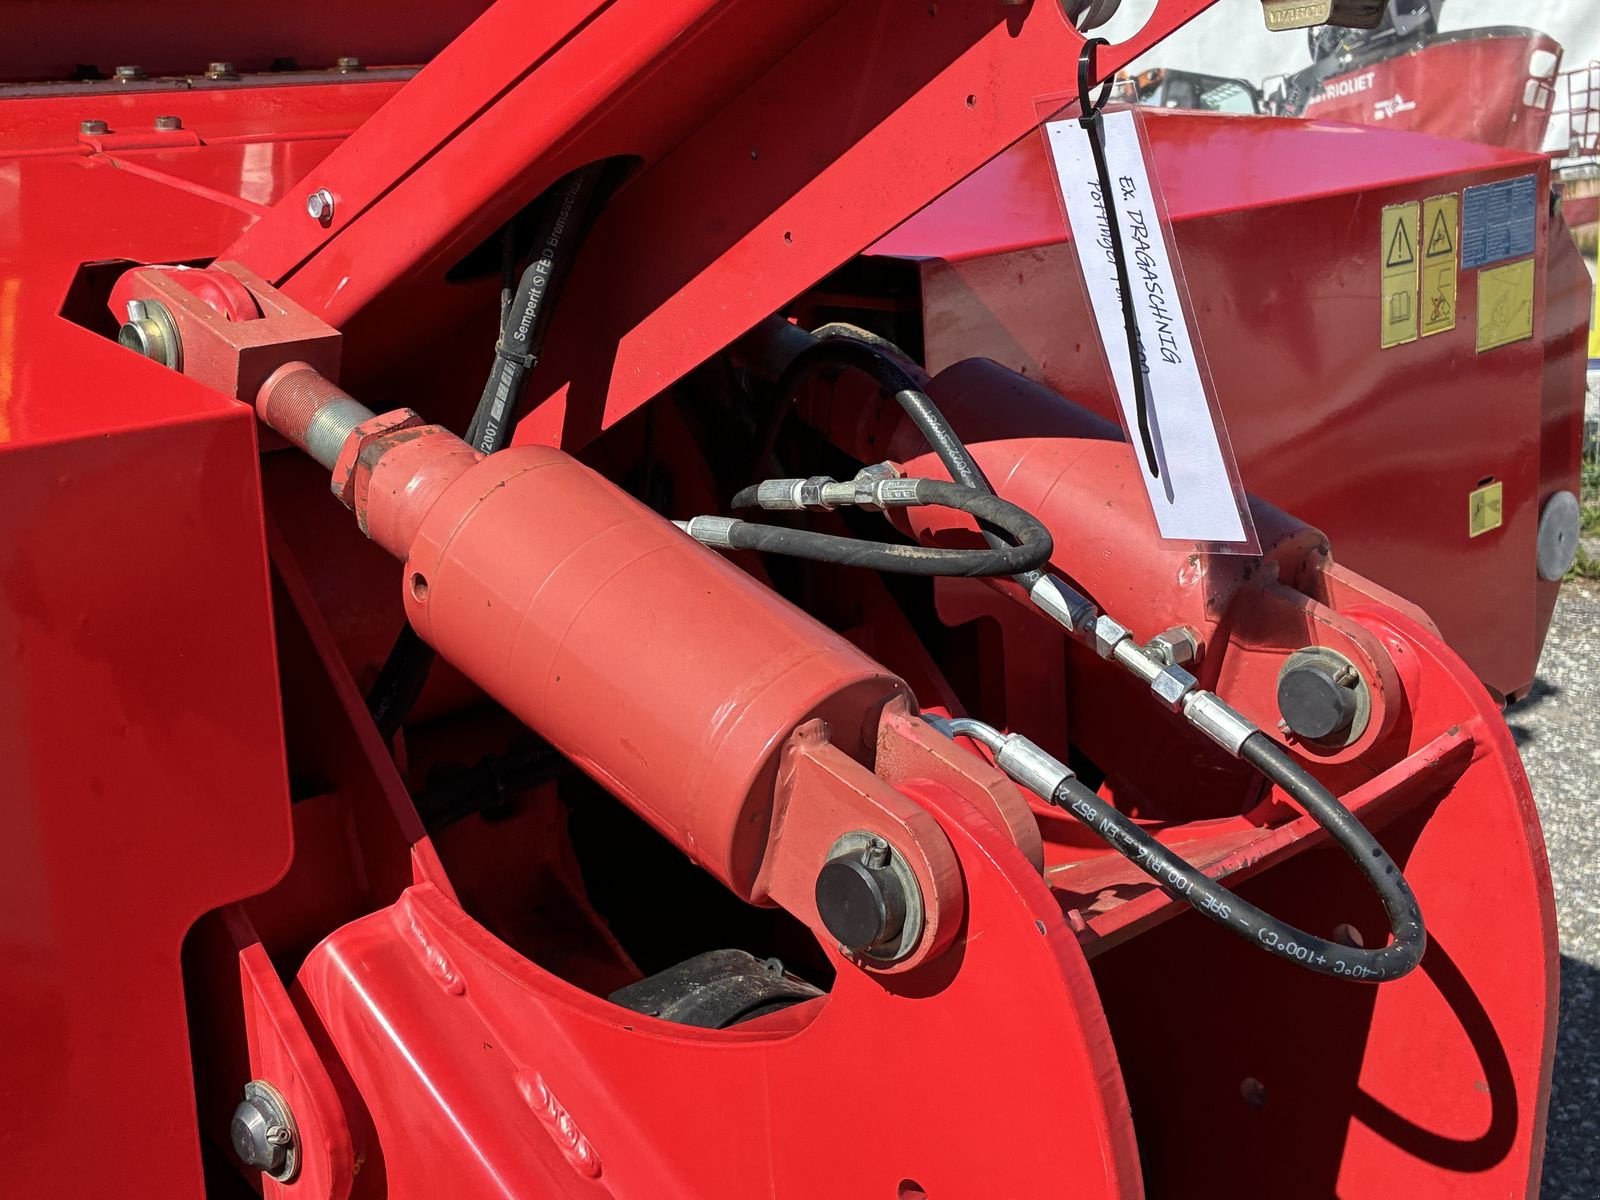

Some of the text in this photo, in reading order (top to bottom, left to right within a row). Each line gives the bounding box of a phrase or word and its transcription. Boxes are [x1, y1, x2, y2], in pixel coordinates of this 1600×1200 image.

[1119, 176, 1136, 201] Ex.
[1126, 209, 1182, 365] DRAGASCHNIG
[513, 287, 541, 343] Semperit
[1072, 799, 1097, 821] 857
[1100, 818, 1119, 839] EN
[1167, 870, 1194, 895] 100
[1200, 893, 1232, 919] SAE
